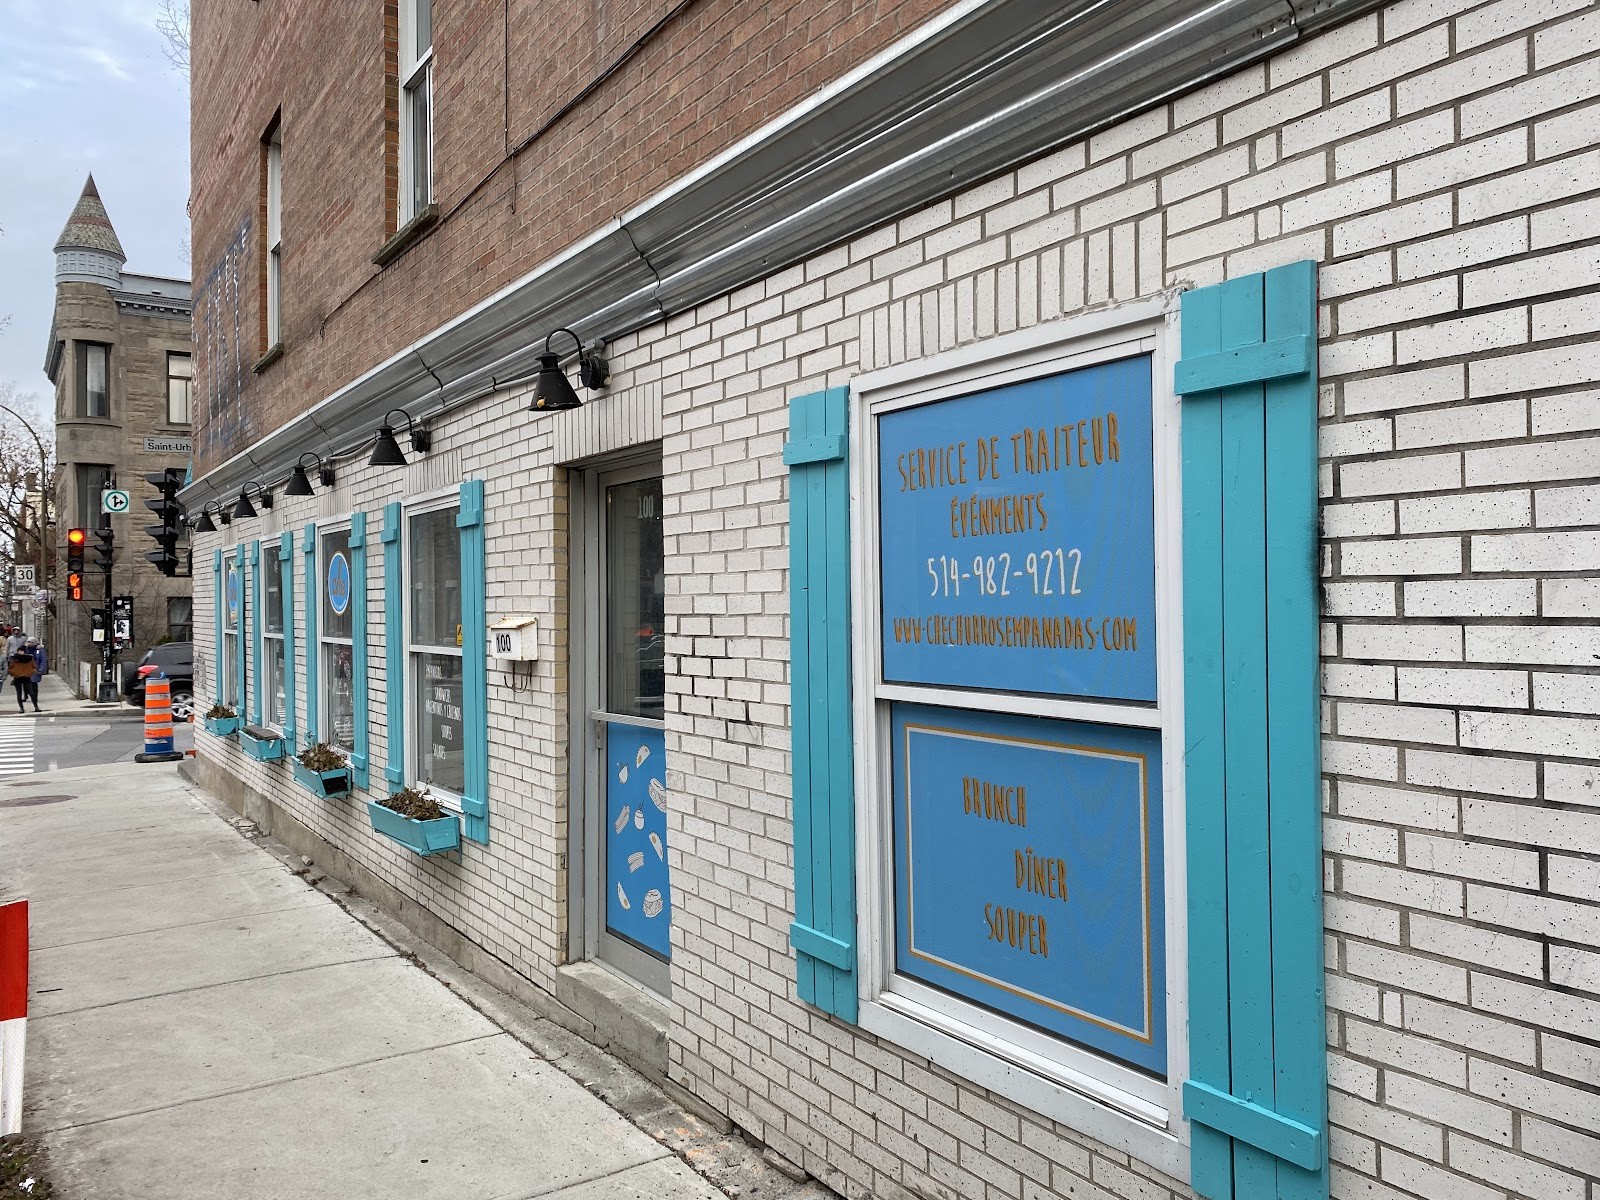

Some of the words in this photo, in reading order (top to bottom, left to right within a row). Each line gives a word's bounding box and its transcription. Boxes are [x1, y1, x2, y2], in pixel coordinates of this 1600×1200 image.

[898, 441, 967, 492] SERVICE
[977, 435, 999, 481] DE
[1011, 412, 1120, 475] TRAITEUR
[637, 495, 653, 519] 100
[950, 492, 1048, 538] ÉVÉNMENTS
[18, 569, 33, 580] 30
[928, 548, 1082, 597] 514-982-9212
[496, 634, 511, 652] 100
[963, 776, 1027, 827] BRUNCH
[1015, 846, 1069, 902] DÎNER
[984, 902, 1048, 958] SOUPER
